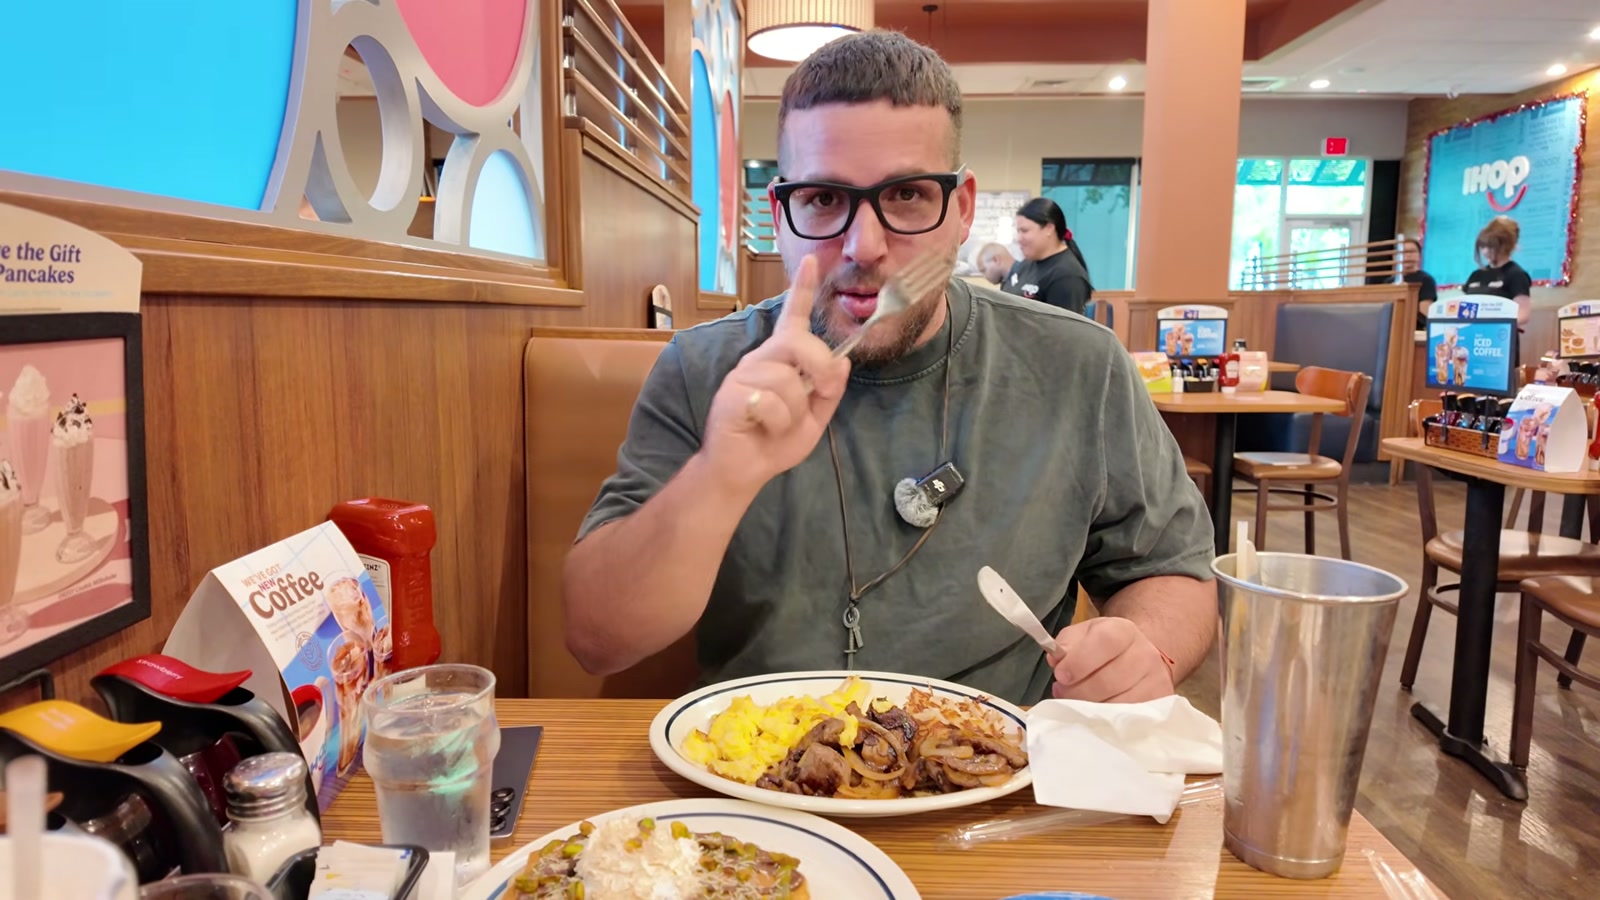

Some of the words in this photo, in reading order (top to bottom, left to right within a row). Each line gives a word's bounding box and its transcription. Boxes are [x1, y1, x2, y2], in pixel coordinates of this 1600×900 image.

[1462, 155, 1531, 199] IHOP
[0, 245, 11, 260] e
[17, 242, 45, 261] the
[50, 244, 82, 263] Gift
[1474, 338, 1492, 347] ICED
[241, 570, 267, 588] WE'VE
[265, 563, 281, 577] GOT
[258, 577, 276, 592] NEW
[249, 571, 325, 619] Coffee
